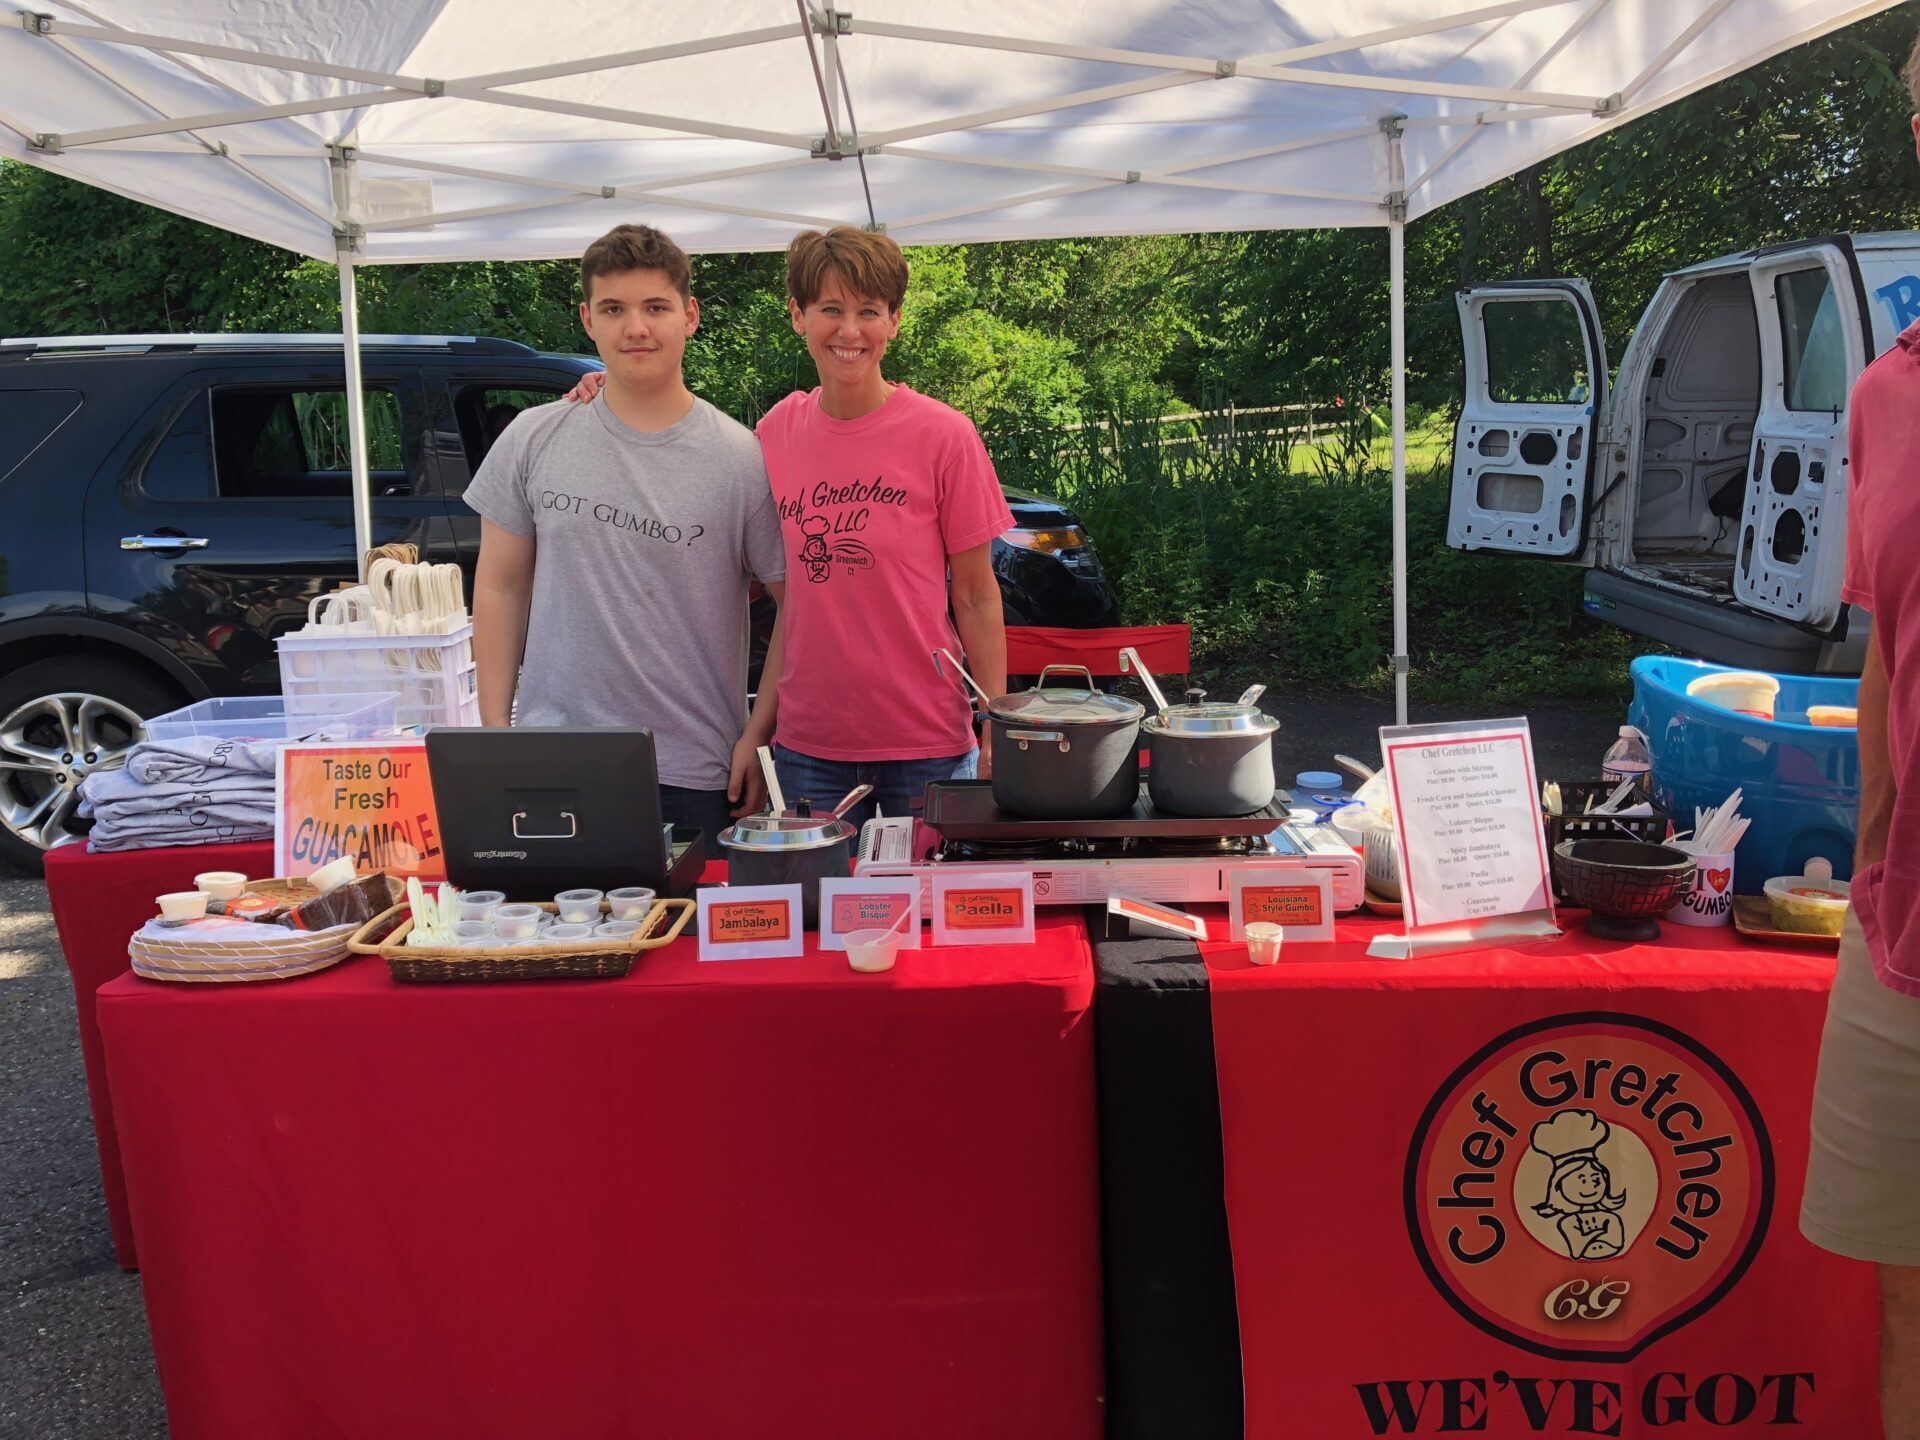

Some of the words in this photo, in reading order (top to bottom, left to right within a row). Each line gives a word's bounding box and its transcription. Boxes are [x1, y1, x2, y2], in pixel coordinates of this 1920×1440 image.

[541, 490, 588, 516] GOT
[775, 487, 806, 525] hef
[812, 476, 907, 507] Gretchen
[834, 508, 869, 534] LLC
[836, 554, 868, 565] Greenwich
[1421, 748, 1440, 759] Chef
[1442, 745, 1477, 757] Gretchen
[1478, 743, 1496, 754] LLC
[323, 759, 372, 781] Taste
[377, 757, 412, 779] Our
[1433, 768, 1456, 776] Gumbo
[1472, 765, 1494, 773] Shrimp
[334, 787, 400, 810] Fresh
[1466, 790, 1489, 799] Seafood
[1490, 788, 1517, 796] Chowder
[292, 813, 441, 869] GUACAMOLE
[1450, 847, 1467, 855] Spicy
[1468, 844, 1501, 852] Jambalaya
[1470, 870, 1489, 878] Paella
[1694, 869, 1707, 891] I
[1268, 895, 1308, 903] Louisiana
[1466, 896, 1500, 905] Guacamole
[1682, 891, 1732, 915] GUMBO
[859, 902, 892, 911] Lobster
[955, 903, 1013, 916] Paella
[1262, 904, 1284, 914] Style
[1285, 903, 1315, 912] Gumbo
[720, 915, 779, 929] Jambalaya
[860, 911, 890, 920] Bisque
[1437, 1090, 1520, 1266] Chef
[1519, 1050, 1735, 1262] Gretchen
[1640, 1371, 1815, 1427] GOT
